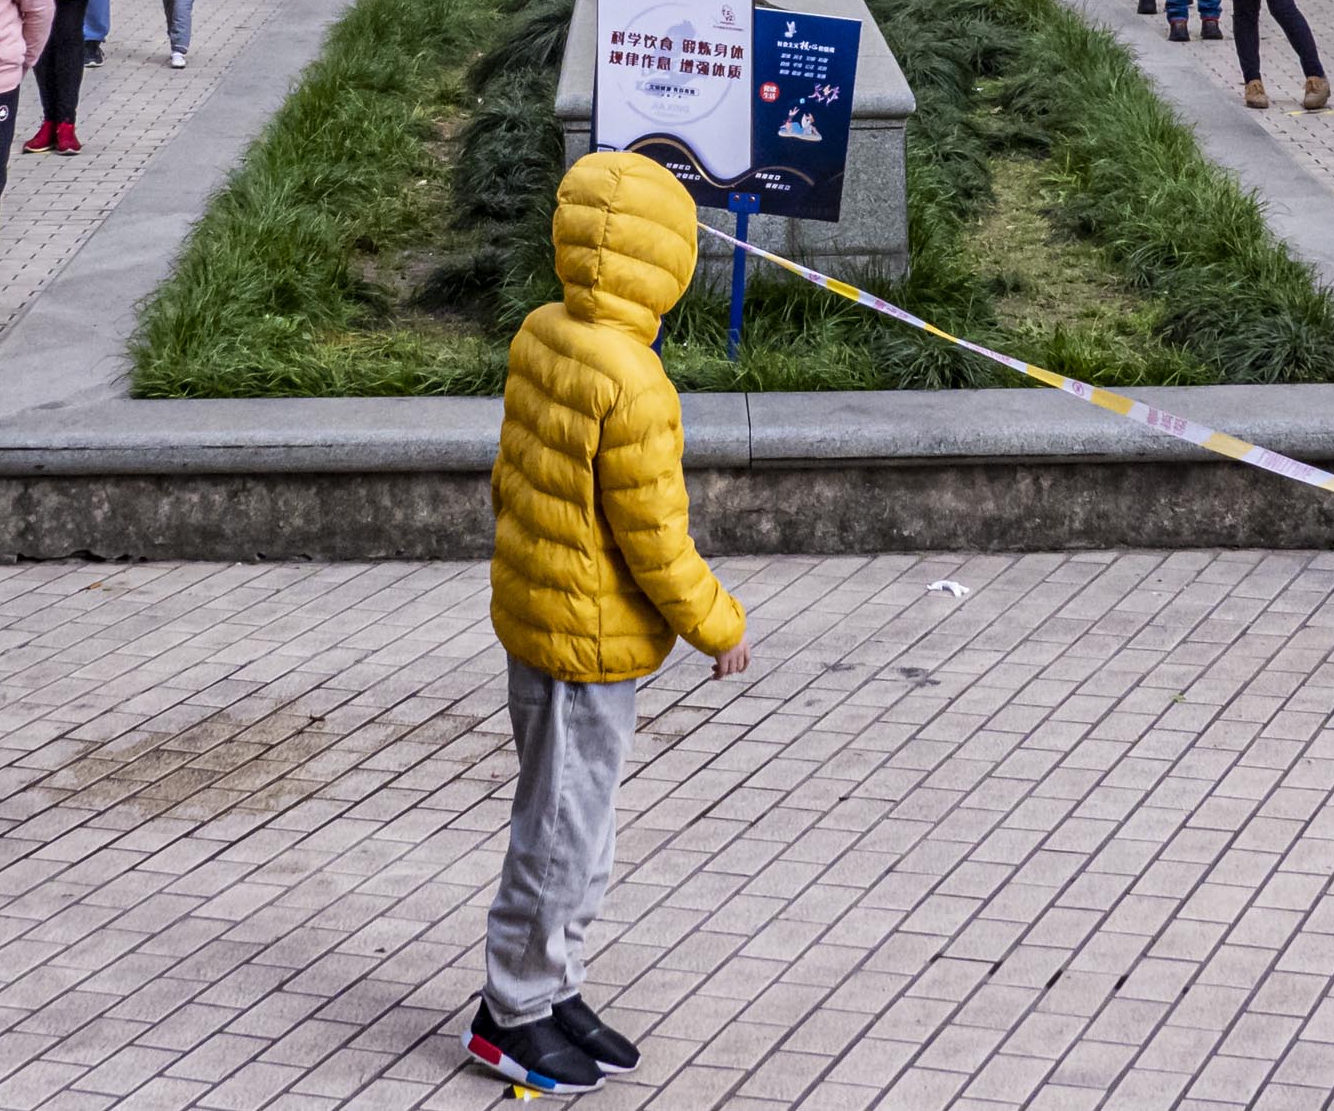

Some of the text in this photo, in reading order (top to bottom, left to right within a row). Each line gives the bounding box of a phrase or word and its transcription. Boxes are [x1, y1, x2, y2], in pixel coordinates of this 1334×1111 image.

[610, 30, 745, 60] 科学饮食 锻炼身体
[608, 50, 743, 80] 规律作息 增强体质
